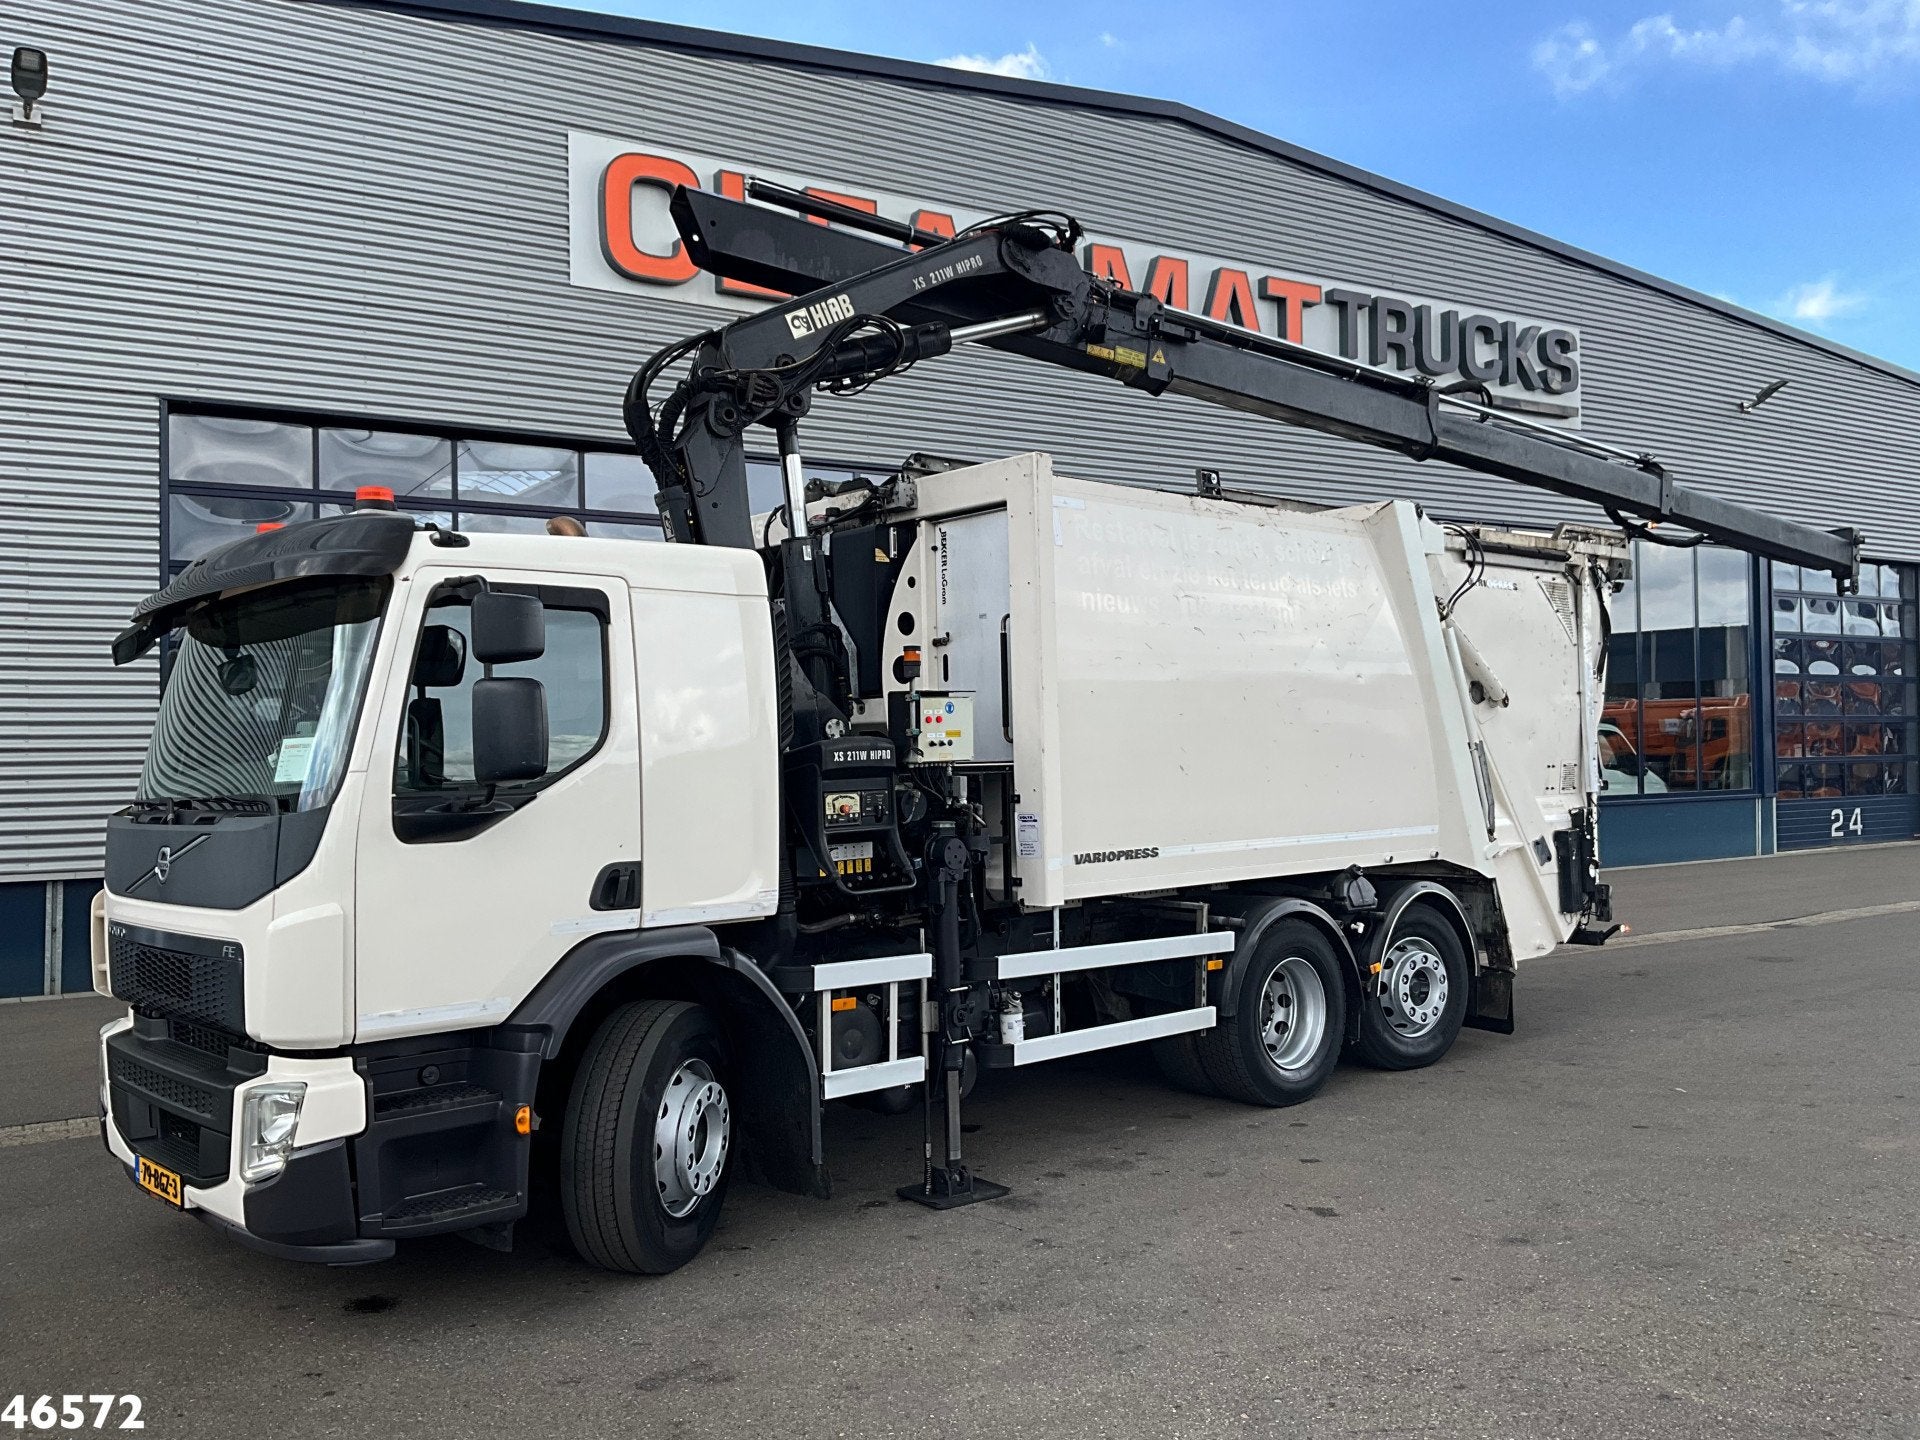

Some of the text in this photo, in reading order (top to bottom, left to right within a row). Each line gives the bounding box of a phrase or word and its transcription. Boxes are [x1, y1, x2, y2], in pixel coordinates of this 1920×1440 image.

[598, 152, 1579, 394] CMAT TRUCKS
[912, 253, 984, 290] XS 211W HIPRO
[810, 294, 855, 330] HIAB
[833, 749, 891, 762] XS 211W HIPRO
[1831, 808, 1863, 837] 24
[1074, 847, 1159, 865] VARIOPRESS
[222, 945, 236, 958] FE
[142, 1161, 178, 1199] 79-BGZ-3
